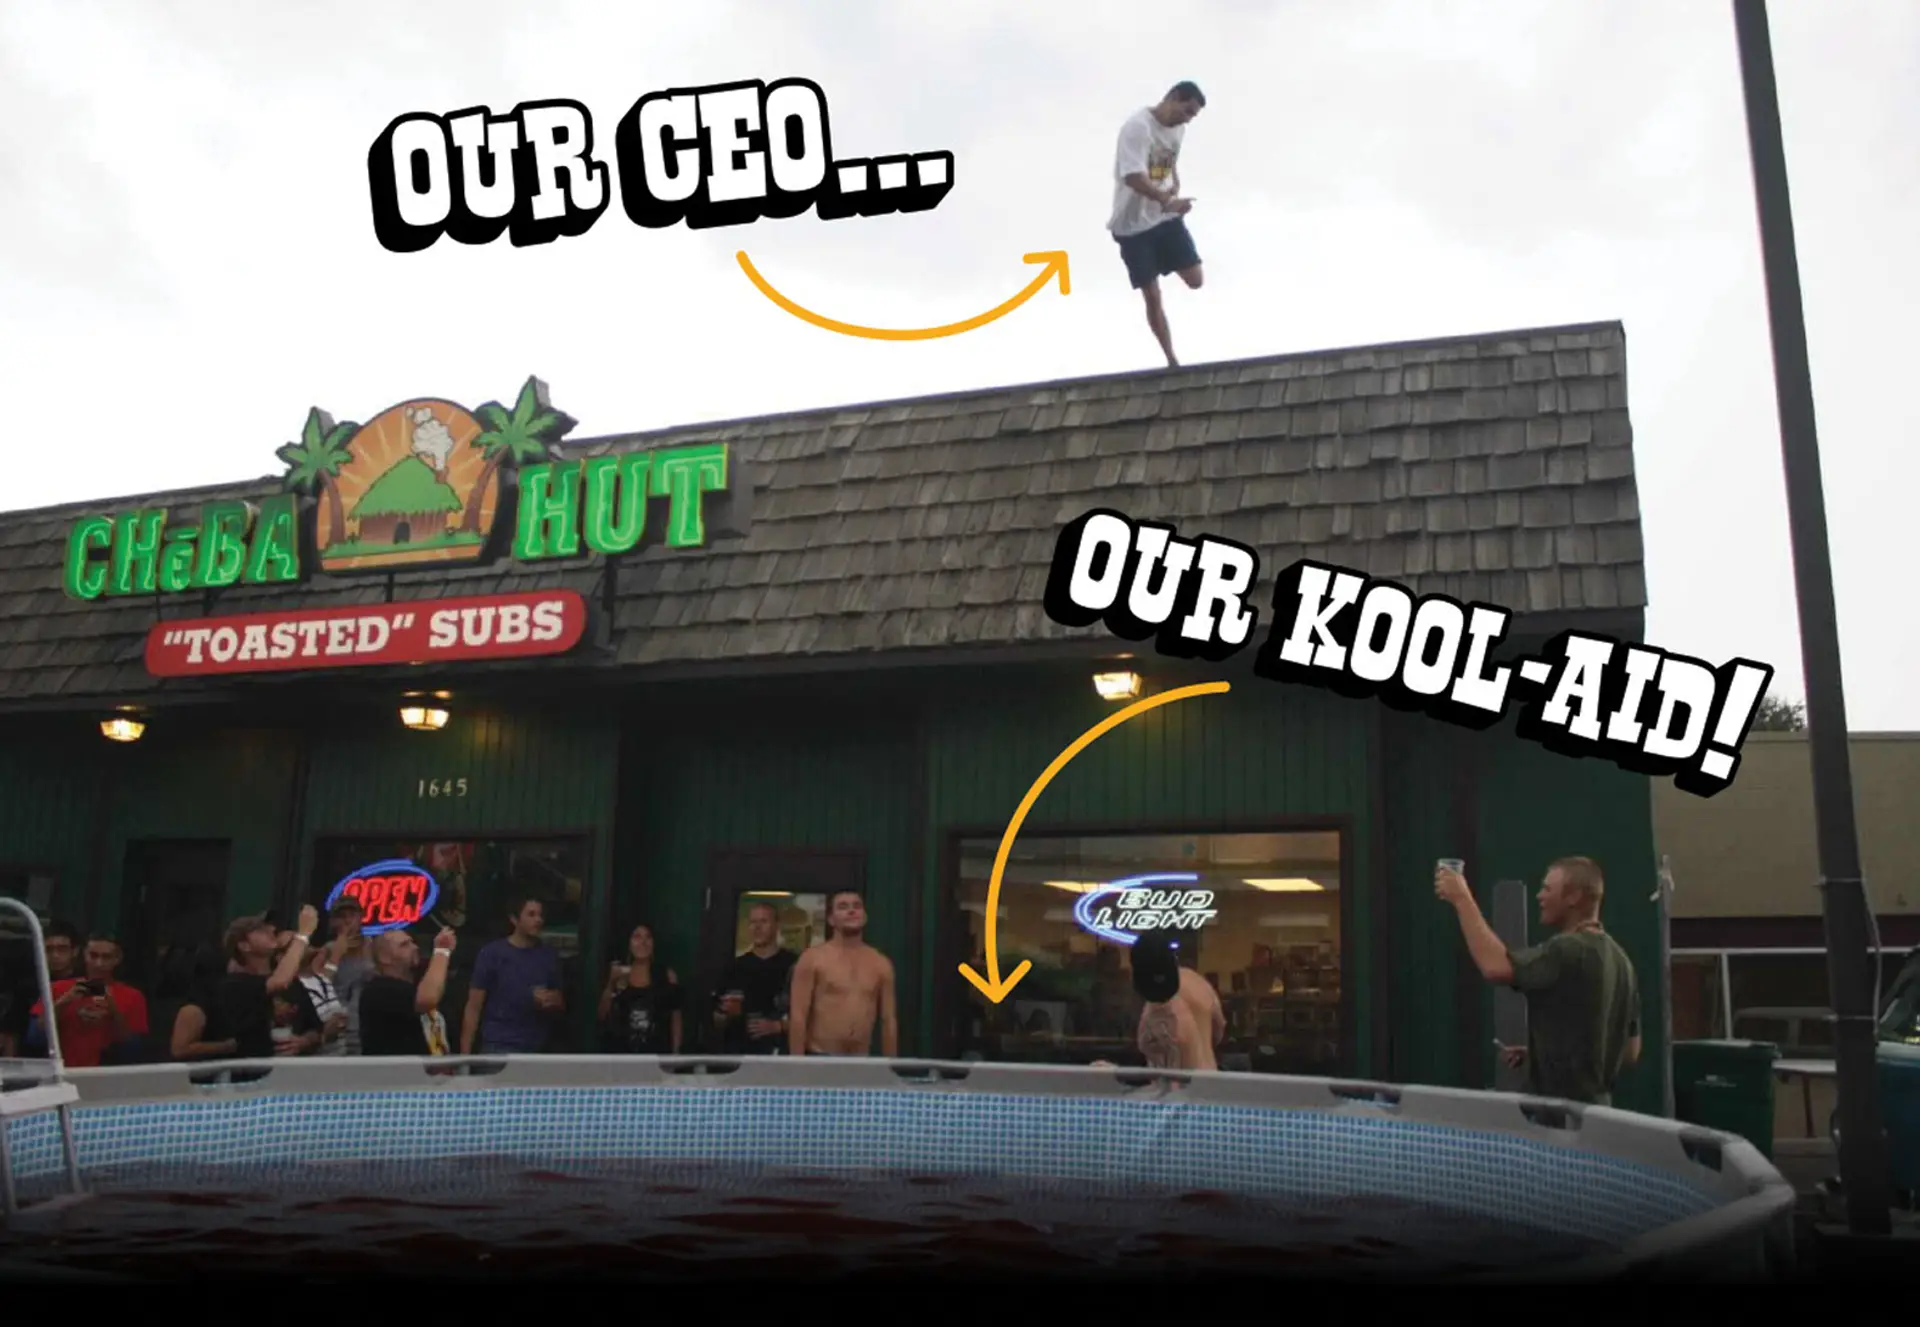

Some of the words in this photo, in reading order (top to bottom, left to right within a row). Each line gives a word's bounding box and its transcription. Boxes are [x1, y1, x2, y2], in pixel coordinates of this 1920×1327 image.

[511, 441, 728, 559] HUT
[428, 600, 565, 649] SUBS
[418, 777, 468, 799] 1645
[1117, 888, 1215, 909] BUD
[1094, 907, 1219, 930] LIGHT
